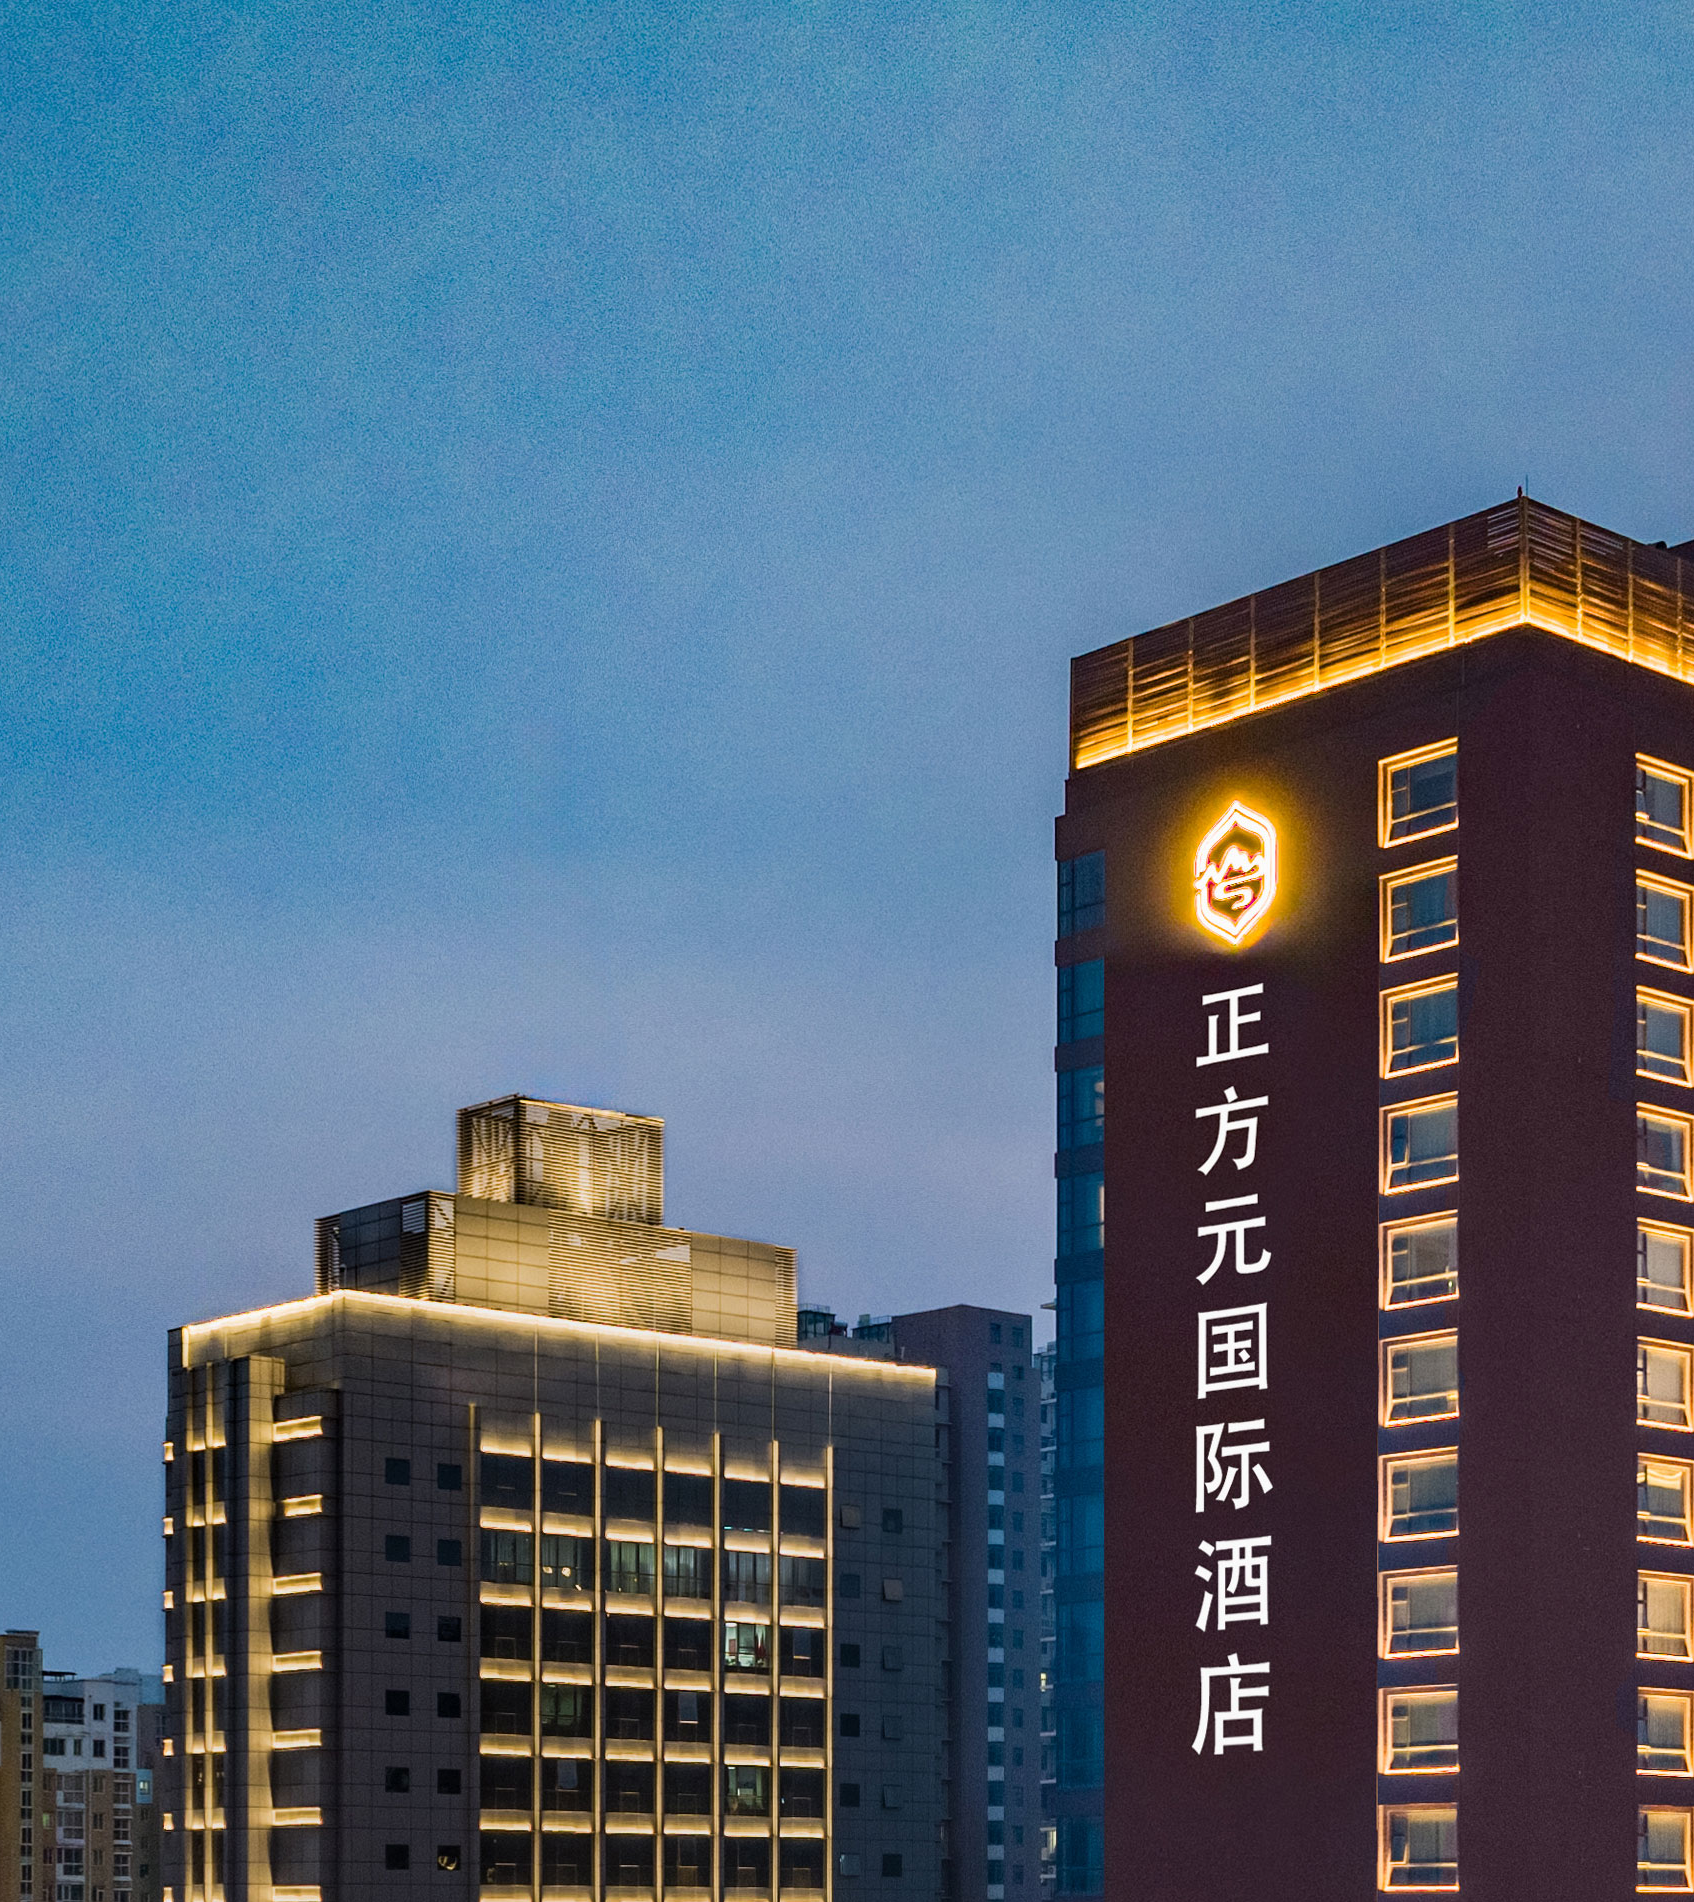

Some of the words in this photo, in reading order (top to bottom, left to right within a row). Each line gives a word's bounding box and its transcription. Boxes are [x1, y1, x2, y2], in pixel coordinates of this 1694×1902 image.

[1191, 982, 1274, 1756] 正方元国际酒店
